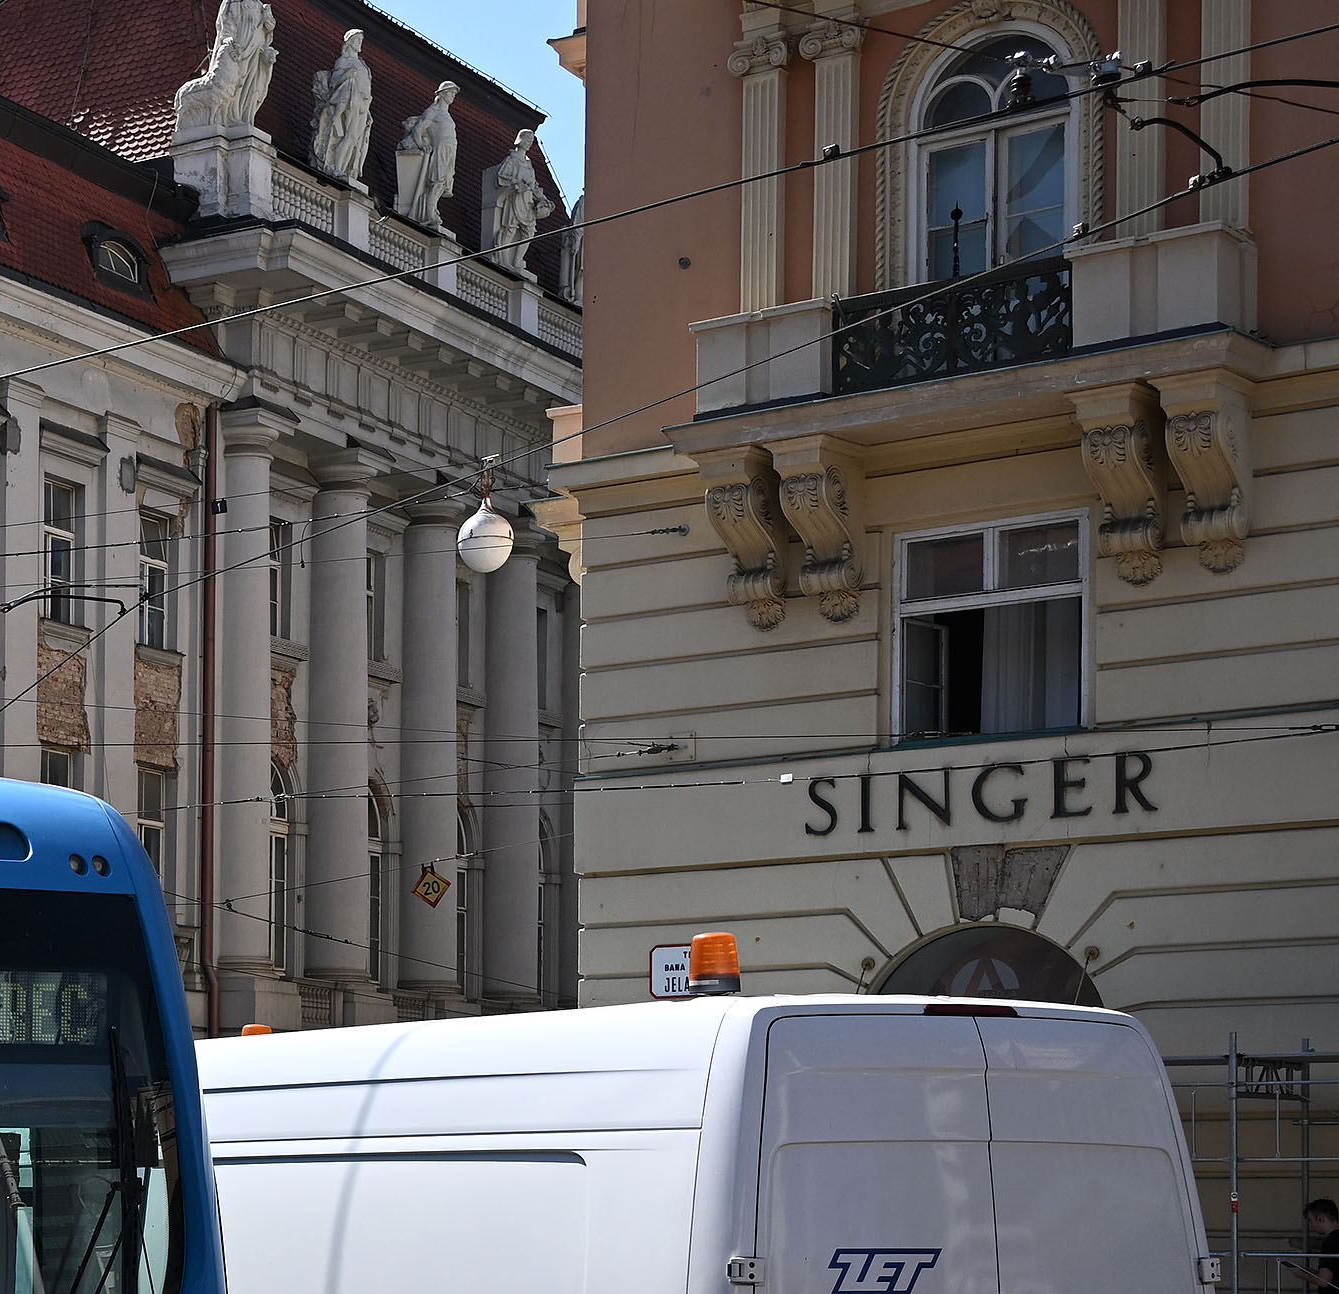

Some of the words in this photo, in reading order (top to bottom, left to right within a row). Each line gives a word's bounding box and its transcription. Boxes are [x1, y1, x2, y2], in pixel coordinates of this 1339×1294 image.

[804, 751, 1159, 838] SINGER
[423, 880, 440, 895] 20
[664, 963, 686, 972] BANA
